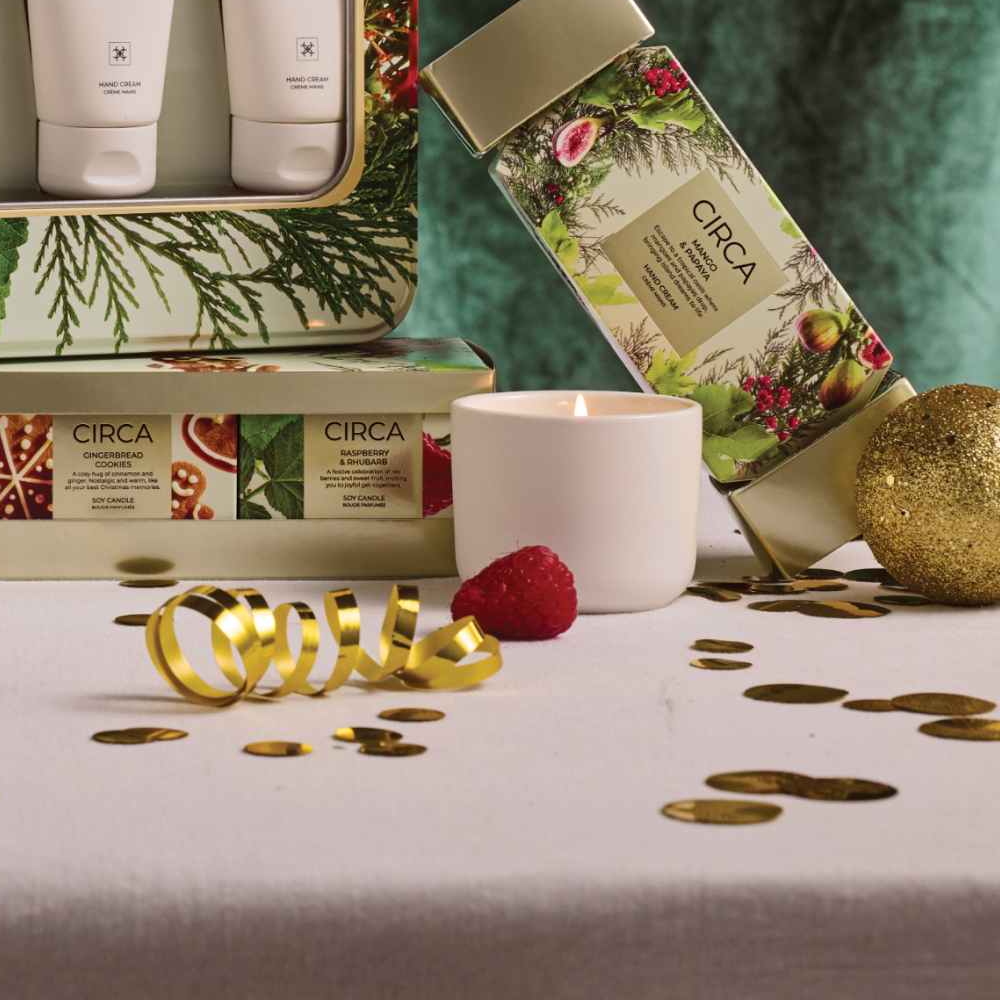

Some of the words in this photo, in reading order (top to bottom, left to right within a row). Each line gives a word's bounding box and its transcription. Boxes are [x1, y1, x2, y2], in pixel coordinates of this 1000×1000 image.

[679, 241, 687, 249] &
[685, 248, 710, 282] PAPAYA
[691, 239, 717, 272] MANGO
[693, 200, 756, 285] CIRCA
[643, 236, 663, 263] bringing
[660, 261, 676, 280] island
[673, 279, 691, 302] dreams
[689, 300, 696, 309] to
[643, 263, 661, 286] HAND
[659, 285, 680, 311] CREAM
[651, 234, 672, 262] mangoes
[670, 261, 681, 274] and
[678, 273, 698, 297] papayas
[654, 224, 670, 246] Escape
[669, 245, 675, 253] to
[677, 257, 696, 279] tropical
[693, 279, 705, 294] oasis
[704, 293, 719, 312] where
[73, 423, 154, 444] CIRCA
[325, 421, 405, 441] CIRCA
[340, 449, 390, 457] RASPBERRY
